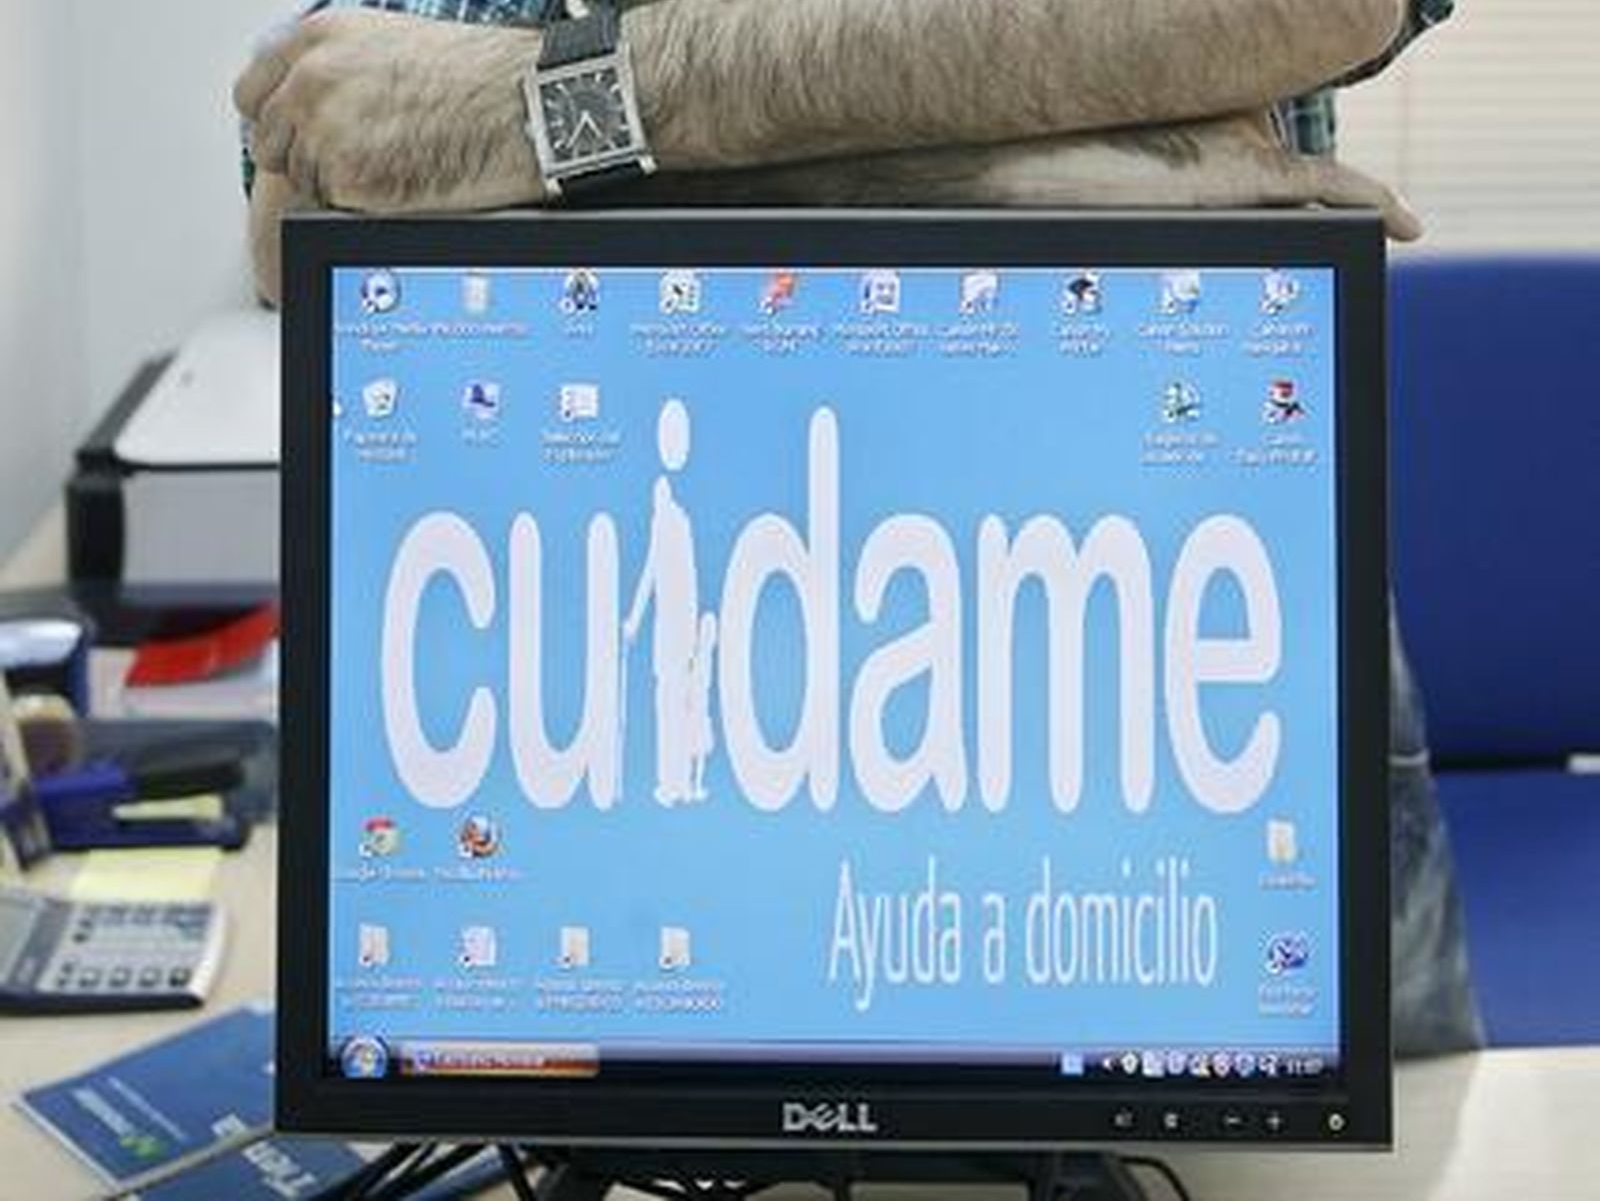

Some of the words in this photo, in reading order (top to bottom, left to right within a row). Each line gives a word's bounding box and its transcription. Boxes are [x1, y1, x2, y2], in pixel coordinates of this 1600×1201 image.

[381, 400, 1282, 813] cuidame
[828, 859, 963, 1012] Ayuda
[982, 891, 1006, 985] a
[1025, 856, 1218, 987] domicilio
[782, 1102, 878, 1133] DELL
